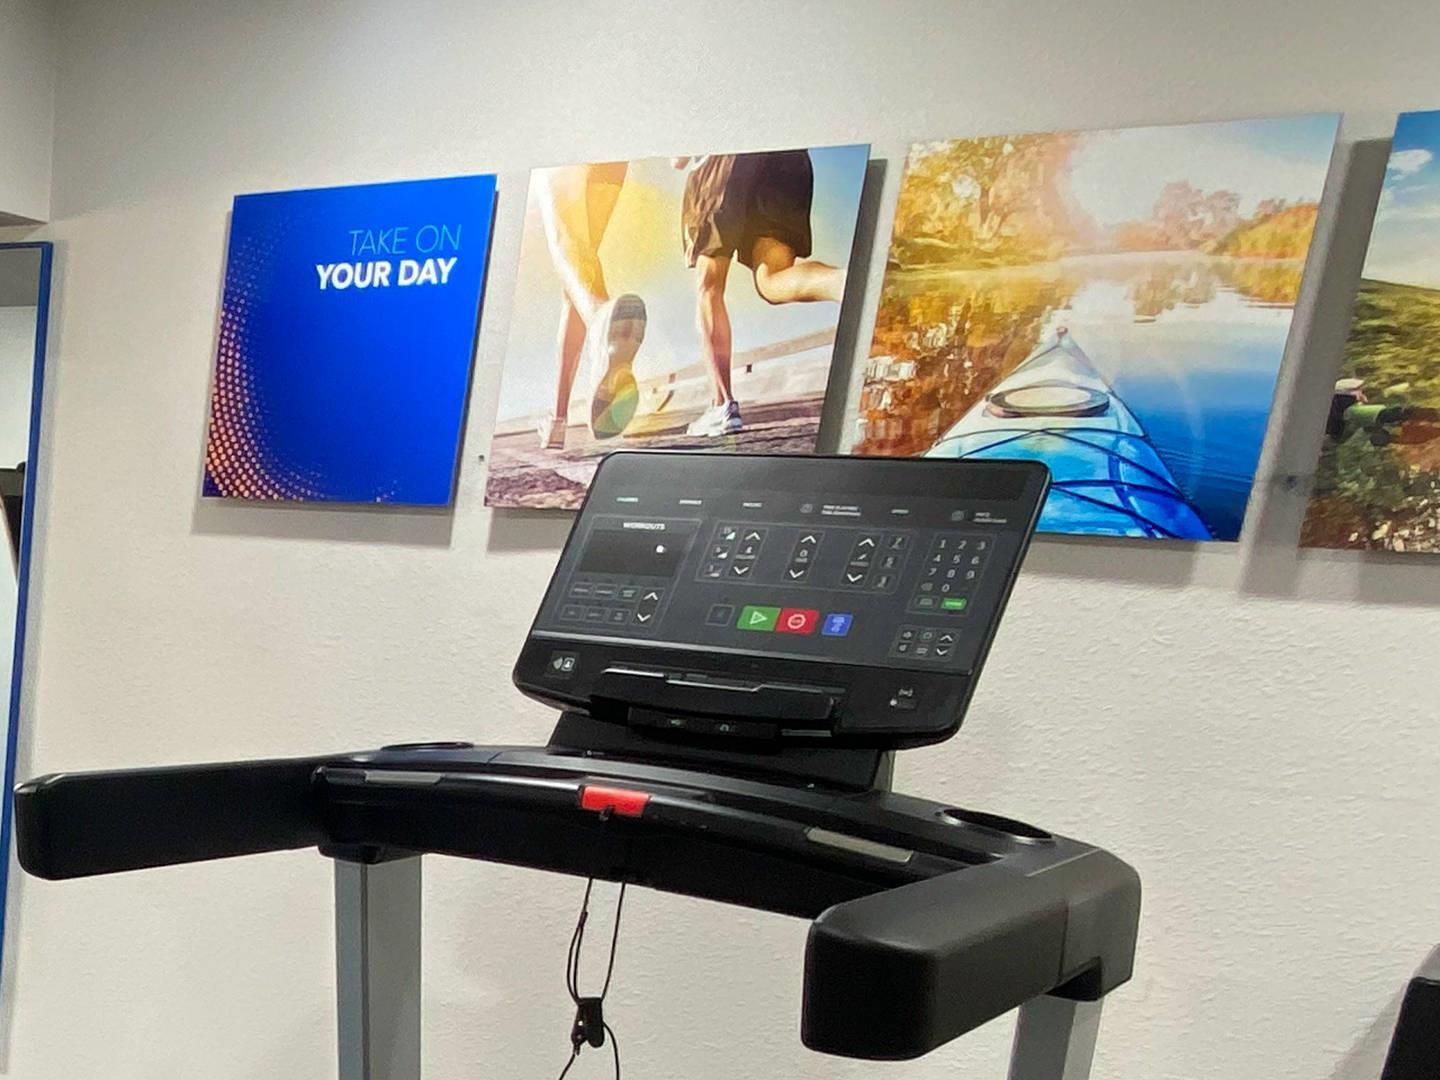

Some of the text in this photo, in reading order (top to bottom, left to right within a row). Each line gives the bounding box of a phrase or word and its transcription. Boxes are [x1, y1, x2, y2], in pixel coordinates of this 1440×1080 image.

[348, 223, 462, 256] TAKE ON
[316, 256, 458, 290] YOUR DAY
[939, 539, 987, 551] 1 2 3
[933, 554, 980, 565] 4 5 6
[927, 567, 938, 576] 7
[966, 570, 976, 580] 9
[941, 583, 951, 593] 0
